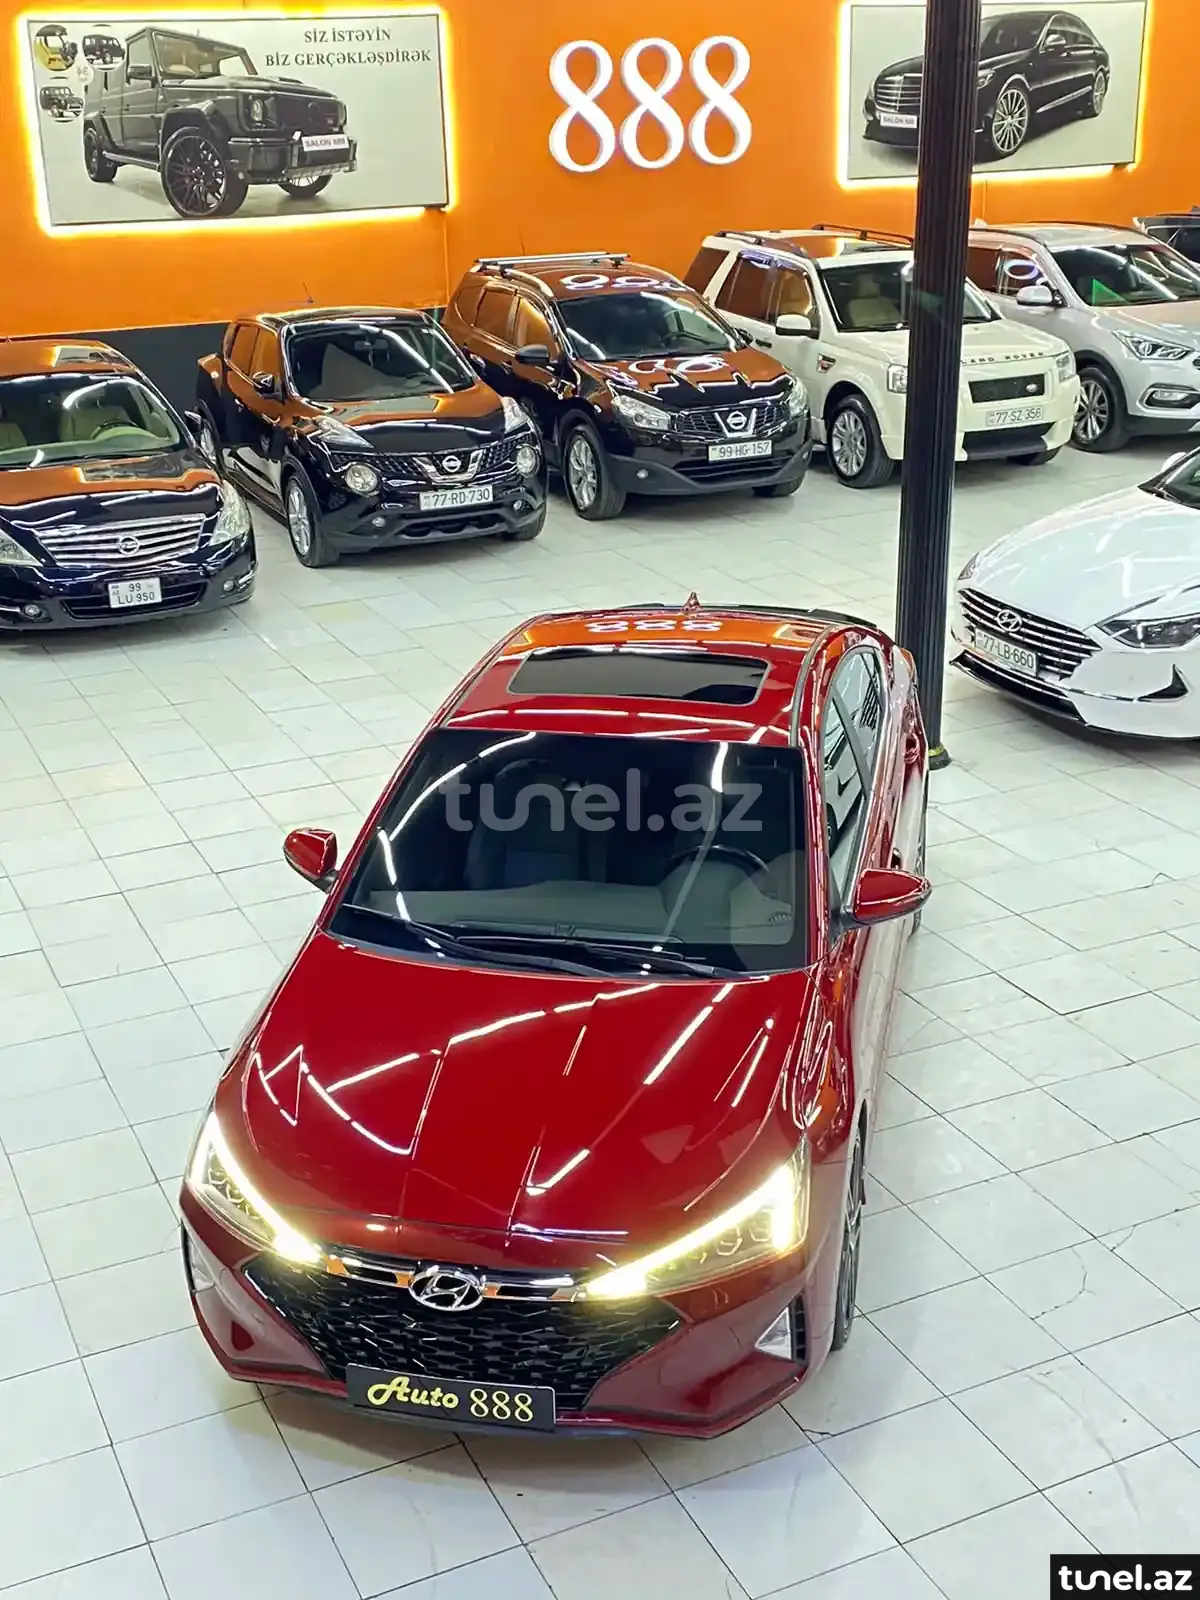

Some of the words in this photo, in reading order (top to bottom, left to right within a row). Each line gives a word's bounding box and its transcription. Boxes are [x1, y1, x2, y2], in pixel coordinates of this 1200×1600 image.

[304, 28, 329, 43] SİZ
[332, 26, 392, 42] İSTƏYİN
[265, 52, 291, 67] BİZ
[294, 48, 432, 67] GERÇƏKLƏŞDİRƏK
[549, 35, 752, 172] 888
[128, 582, 141, 592] 99
[367, 1376, 460, 1409] Auto
[470, 1388, 534, 1422] 888
